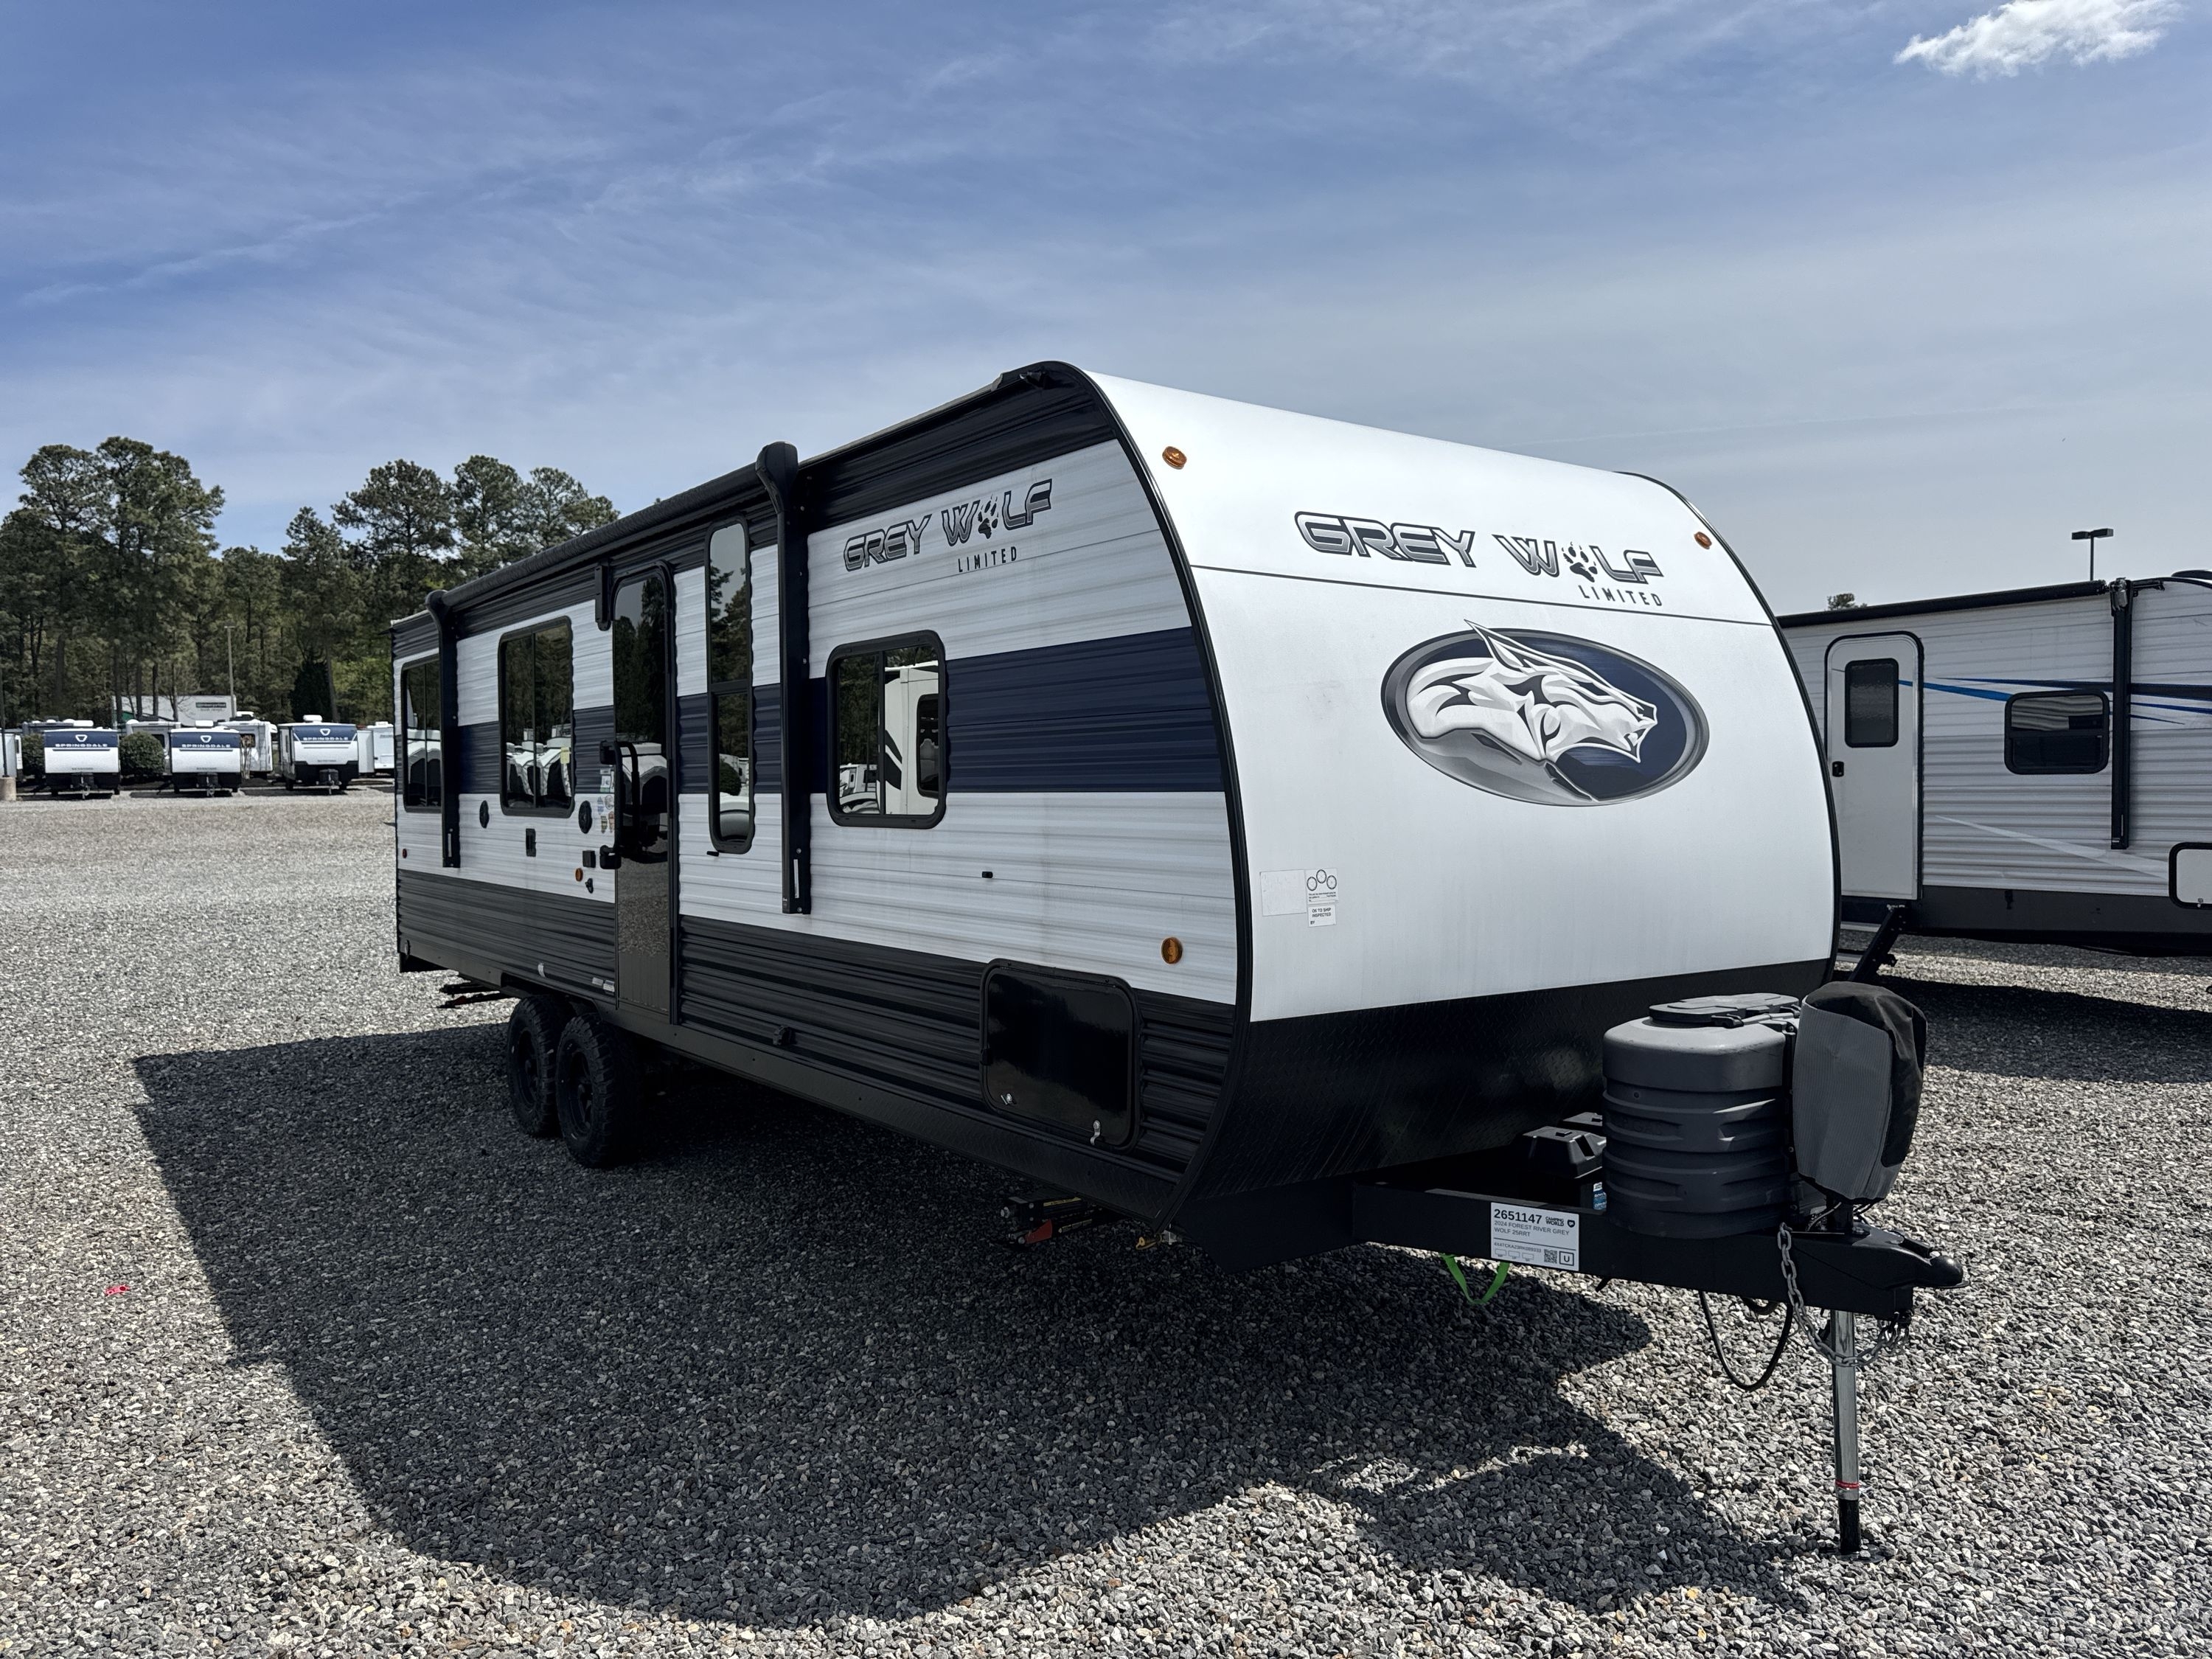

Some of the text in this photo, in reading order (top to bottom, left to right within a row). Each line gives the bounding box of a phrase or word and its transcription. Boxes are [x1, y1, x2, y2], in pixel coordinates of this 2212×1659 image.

[844, 514, 932, 572] GREY
[1294, 511, 1477, 568] GREY
[958, 546, 1018, 573] LIMITED
[1578, 584, 1663, 607] LIMITED
[1494, 1208, 1542, 1224] 2651147
[1509, 1222, 1532, 1230] FOREST
